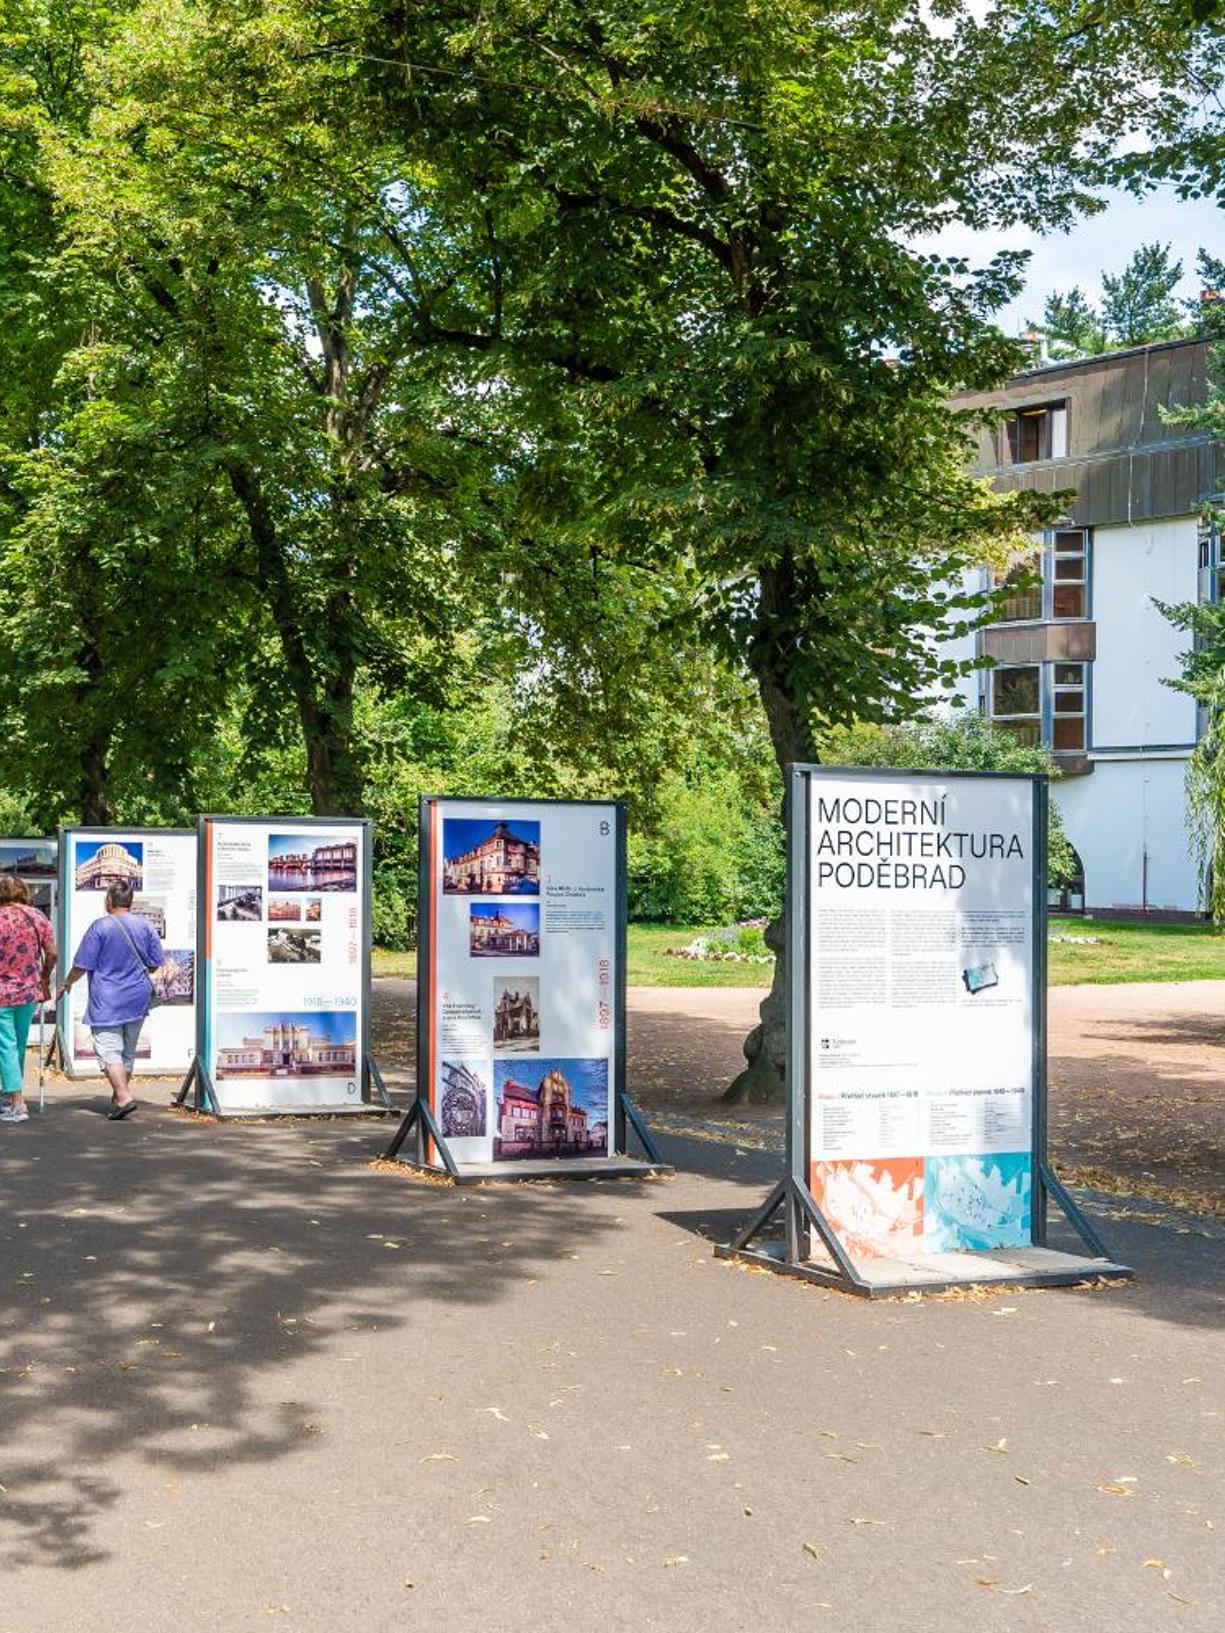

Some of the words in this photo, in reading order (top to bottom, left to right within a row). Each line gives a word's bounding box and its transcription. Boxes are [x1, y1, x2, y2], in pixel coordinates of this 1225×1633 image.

[818, 794, 947, 825] MODERNÍ
[599, 820, 610, 836] B
[817, 830, 1024, 859] ARCHITEKTURA
[818, 857, 966, 889] PODĚBRAD
[347, 1082, 356, 1094] D
